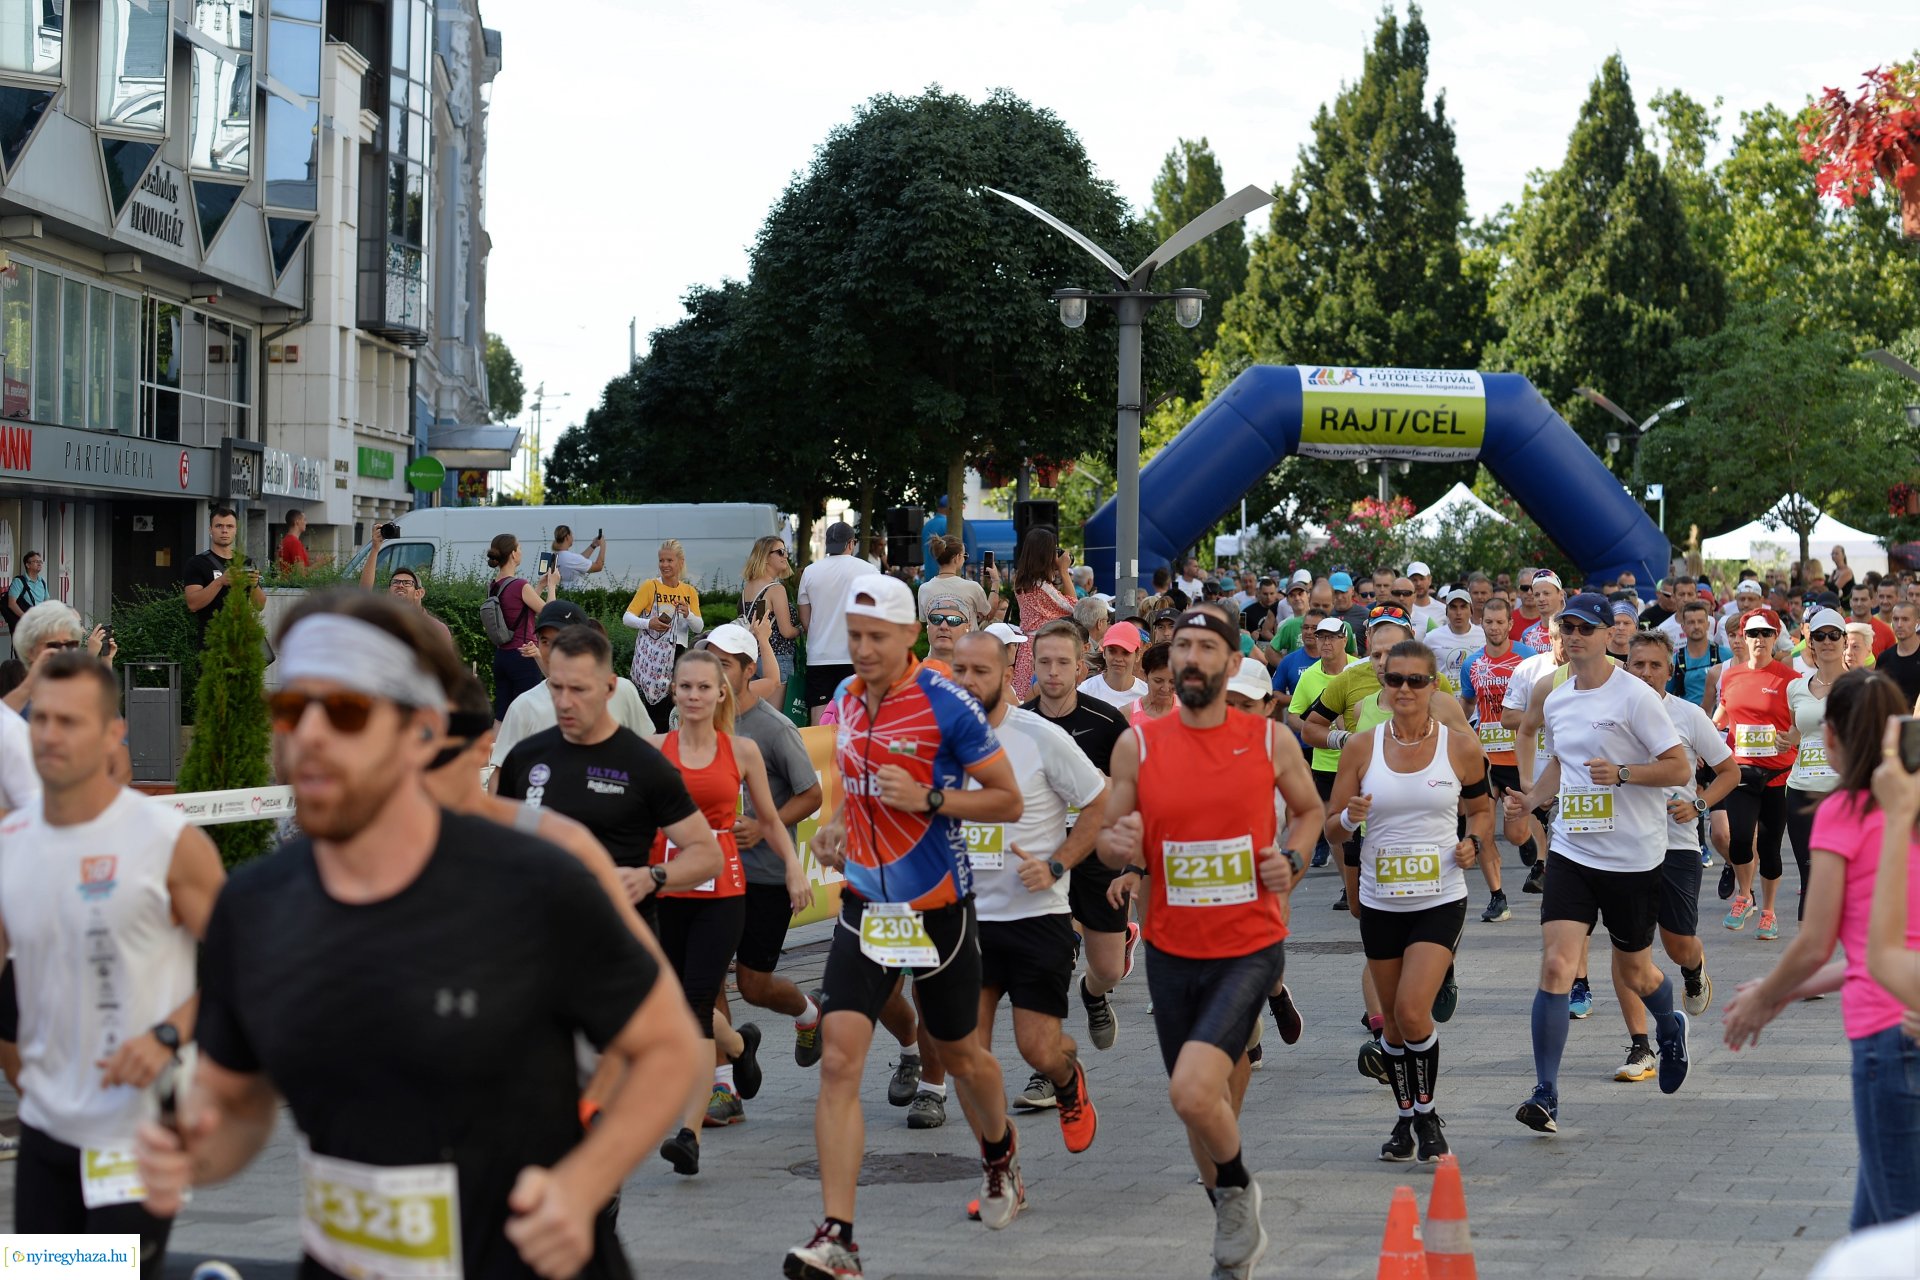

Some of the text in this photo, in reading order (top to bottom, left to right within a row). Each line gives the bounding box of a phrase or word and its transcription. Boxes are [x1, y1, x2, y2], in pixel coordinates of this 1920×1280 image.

[1320, 403, 1467, 435] RAJT/CÉL
[65, 440, 153, 480] PARFÜMÉRIA
[1481, 728, 1511, 740] 2128
[1739, 732, 1773, 743] 2340
[1802, 749, 1827, 762] 229
[586, 766, 629, 782] ULTRA
[1563, 795, 1604, 812] 2151
[1173, 854, 1242, 879] 2211
[1378, 856, 1433, 876] 2160
